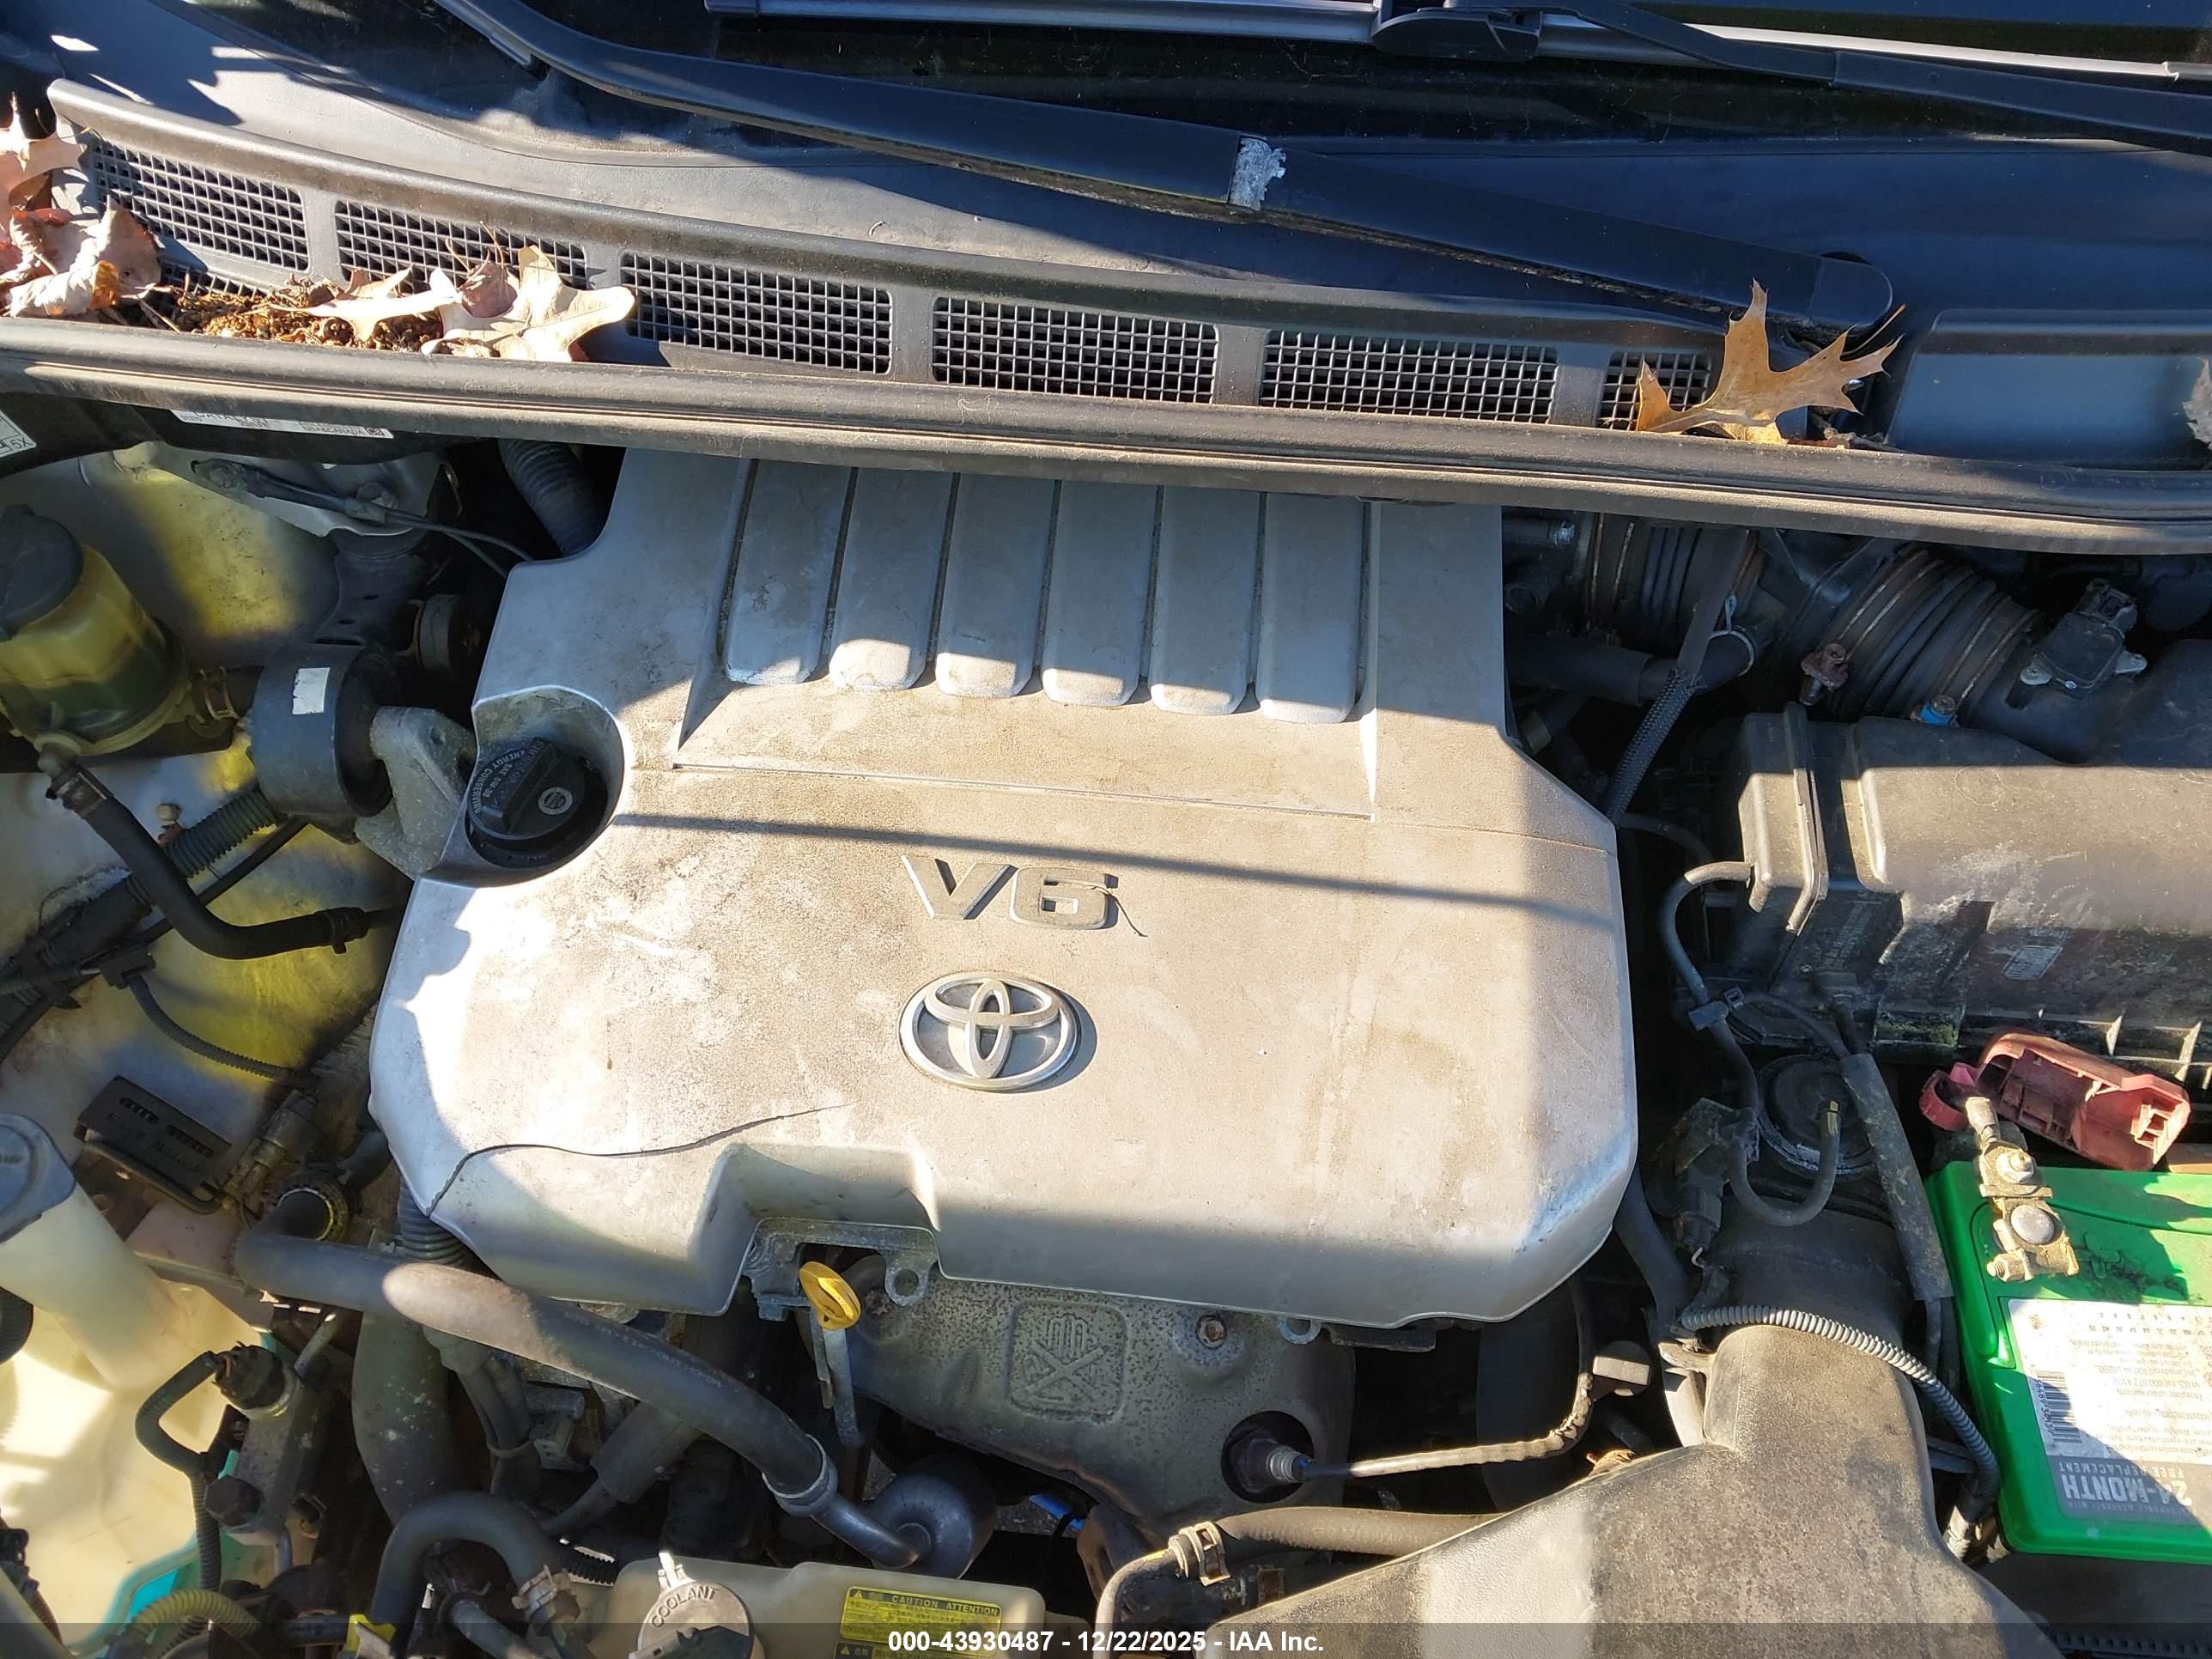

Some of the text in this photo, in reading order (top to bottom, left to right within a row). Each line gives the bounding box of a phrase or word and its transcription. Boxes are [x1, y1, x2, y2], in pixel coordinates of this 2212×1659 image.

[493, 750, 526, 769] ENERGY
[472, 768, 493, 814] CONSERVING
[902, 854, 1120, 929] V6
[2058, 1462, 2185, 1479] FREE REPLACEMENT
[2061, 1474, 2193, 1506] 24-MONTH
[651, 1585, 720, 1628] COOLANT
[891, 1595, 939, 1608] CAUTION
[946, 1601, 998, 1616] ATTENTION
